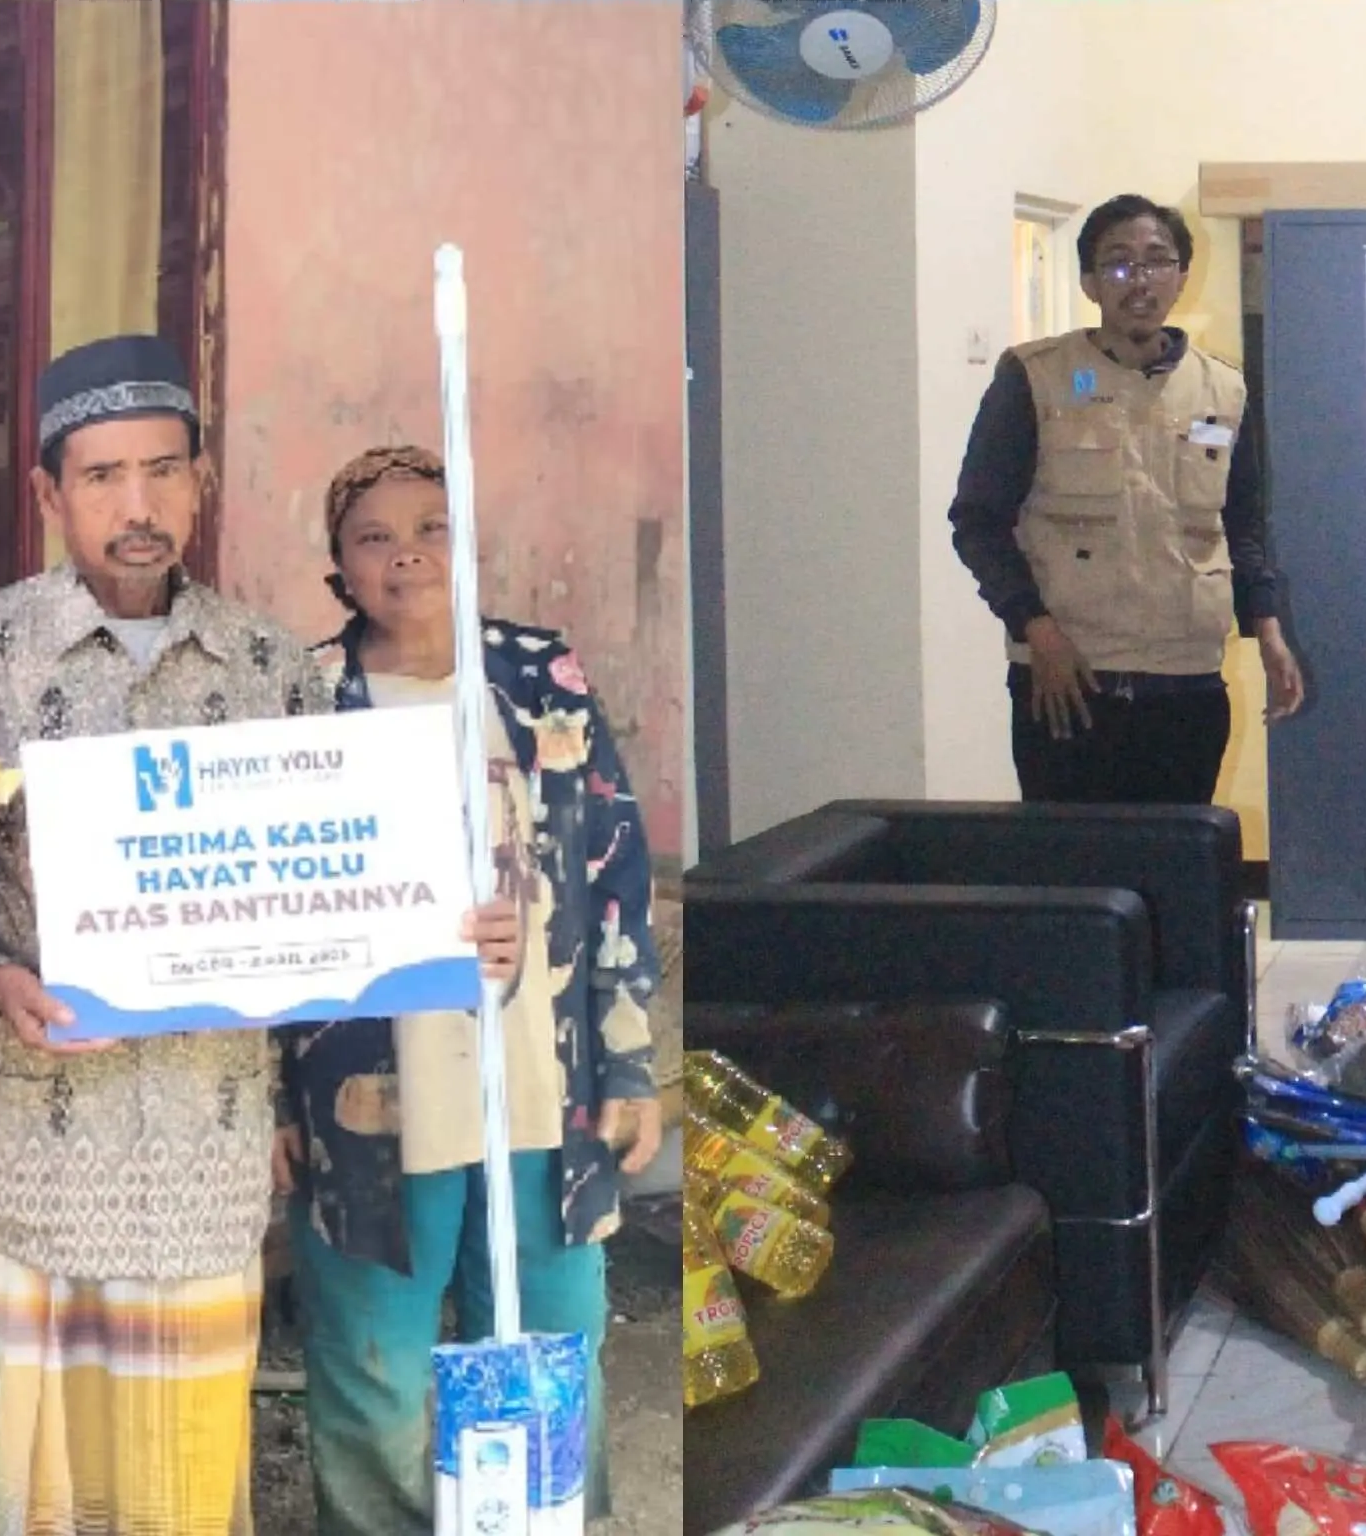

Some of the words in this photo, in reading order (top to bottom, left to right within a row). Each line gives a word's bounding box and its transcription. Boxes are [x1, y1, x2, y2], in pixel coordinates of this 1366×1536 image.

[278, 749, 343, 772] YOLU
[116, 827, 255, 860] TERIMA
[266, 815, 379, 846] KASIH
[137, 861, 257, 894] HAYAT
[270, 853, 365, 879] YOLU
[74, 899, 169, 935] ATAS
[181, 881, 436, 926] BANTUANNYA
